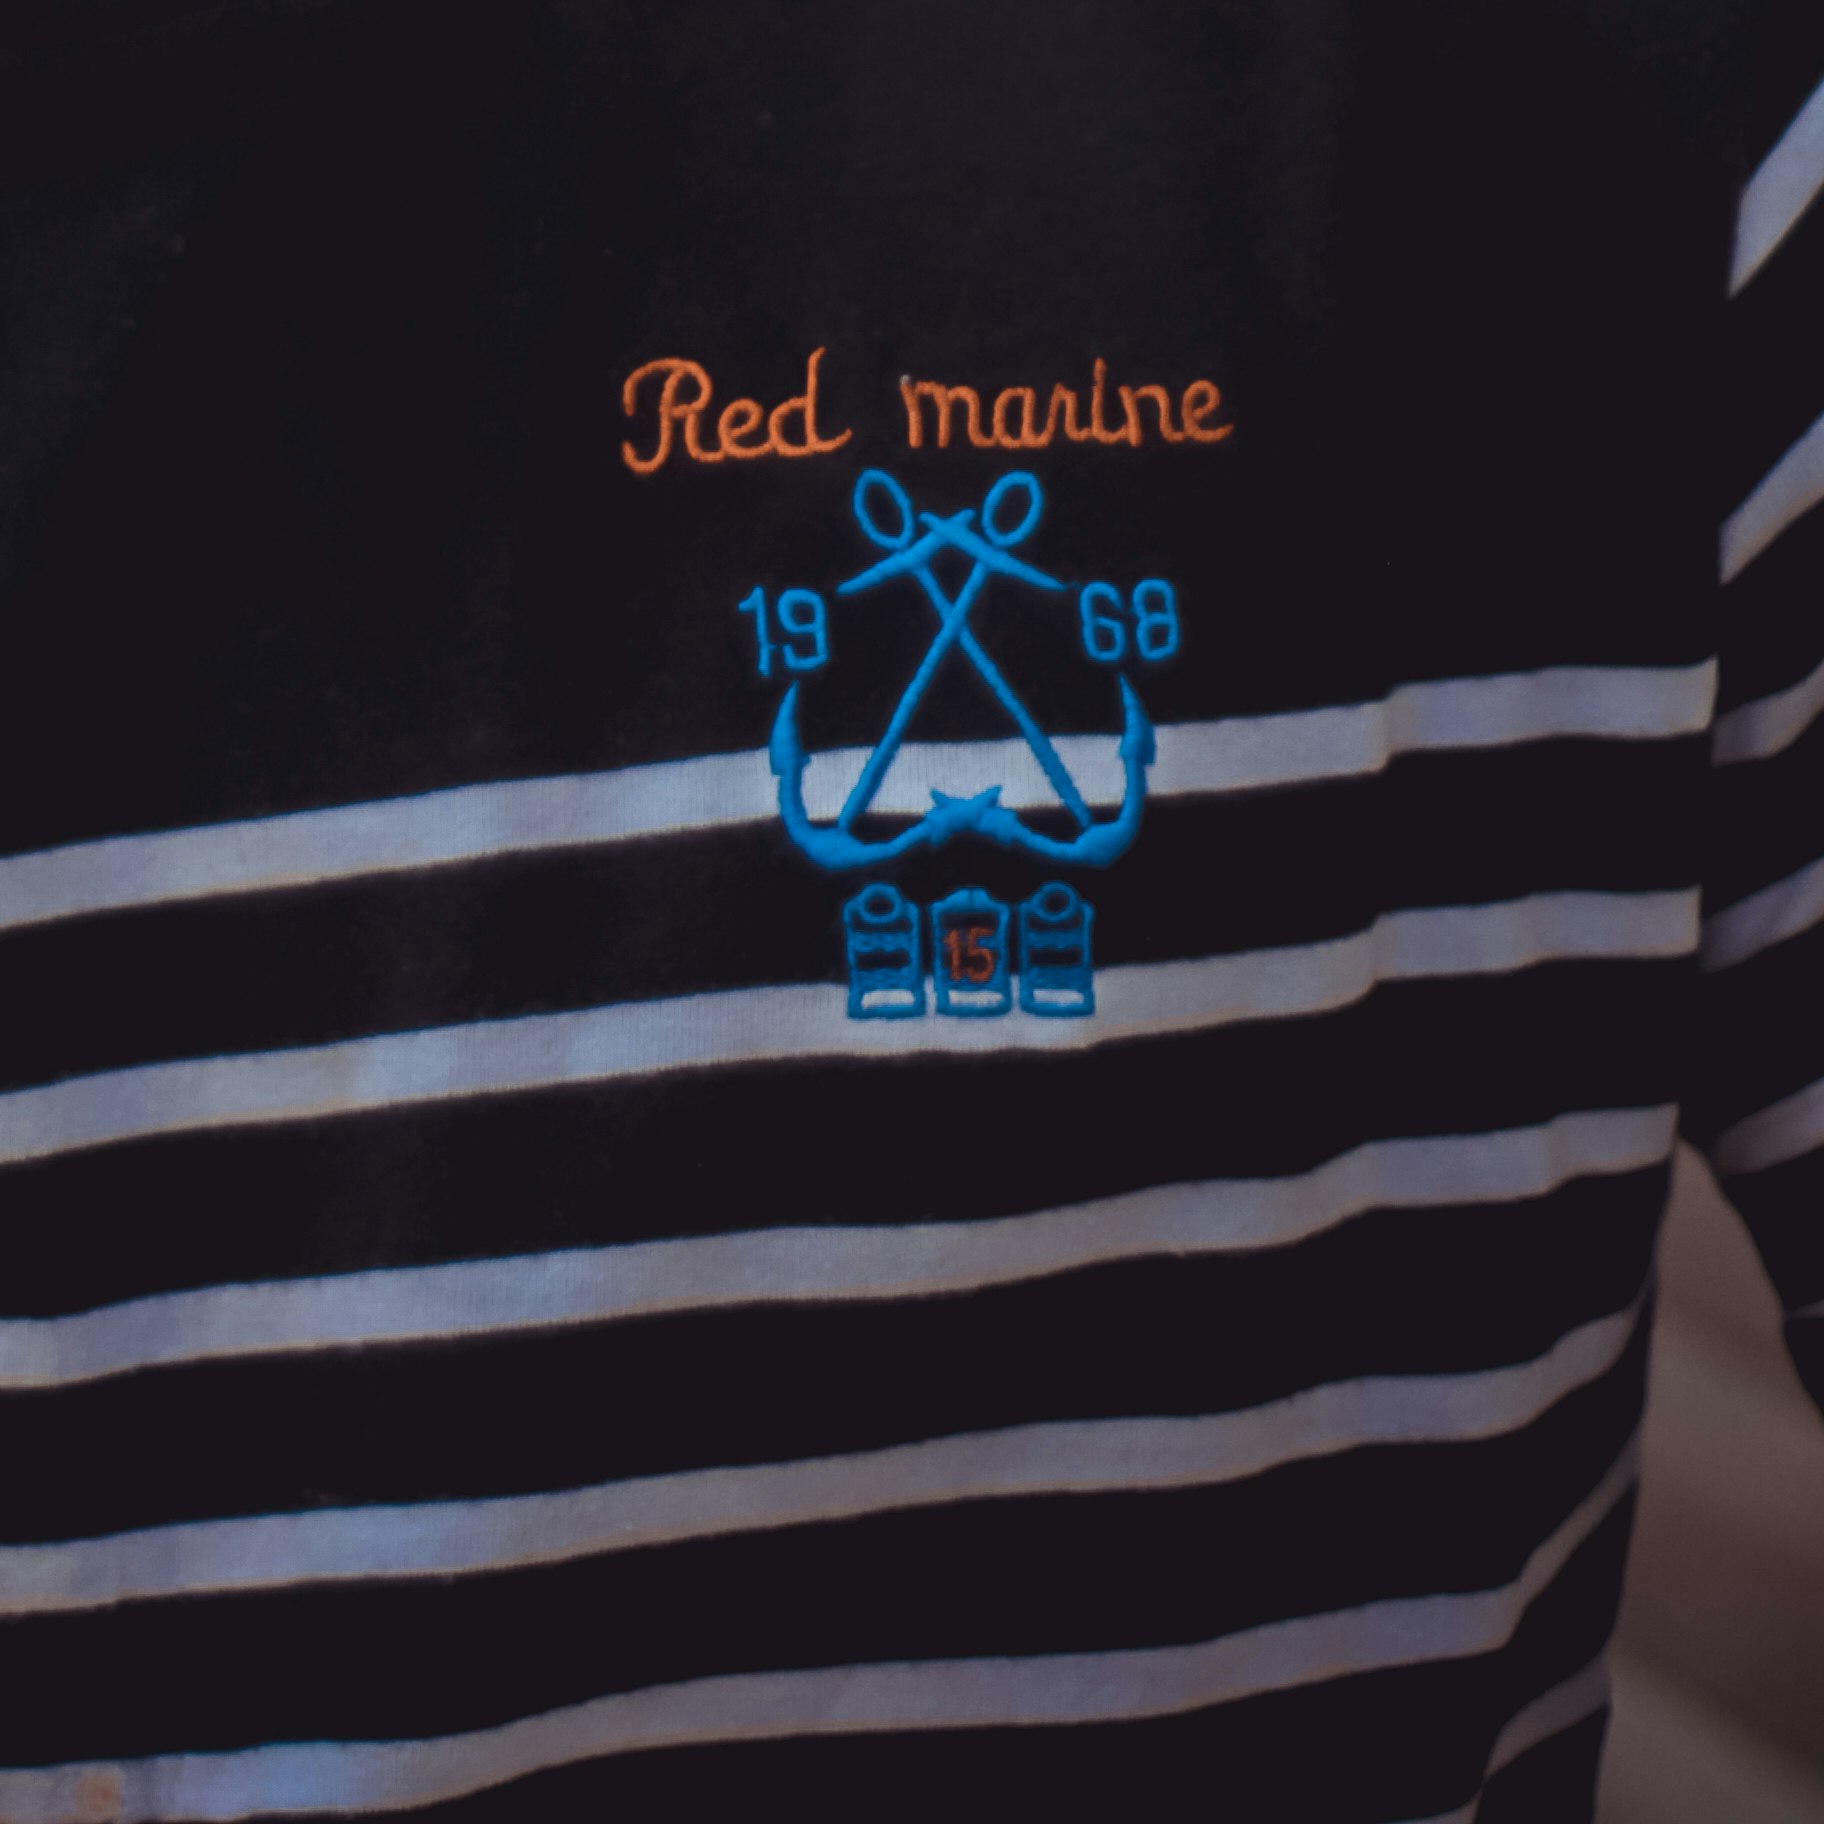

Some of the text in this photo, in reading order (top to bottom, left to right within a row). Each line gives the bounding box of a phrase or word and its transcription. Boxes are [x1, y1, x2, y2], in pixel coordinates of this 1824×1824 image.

[620, 346, 1235, 477] Red marine
[737, 578, 1179, 677] 19 68
[944, 926, 995, 982] 15
